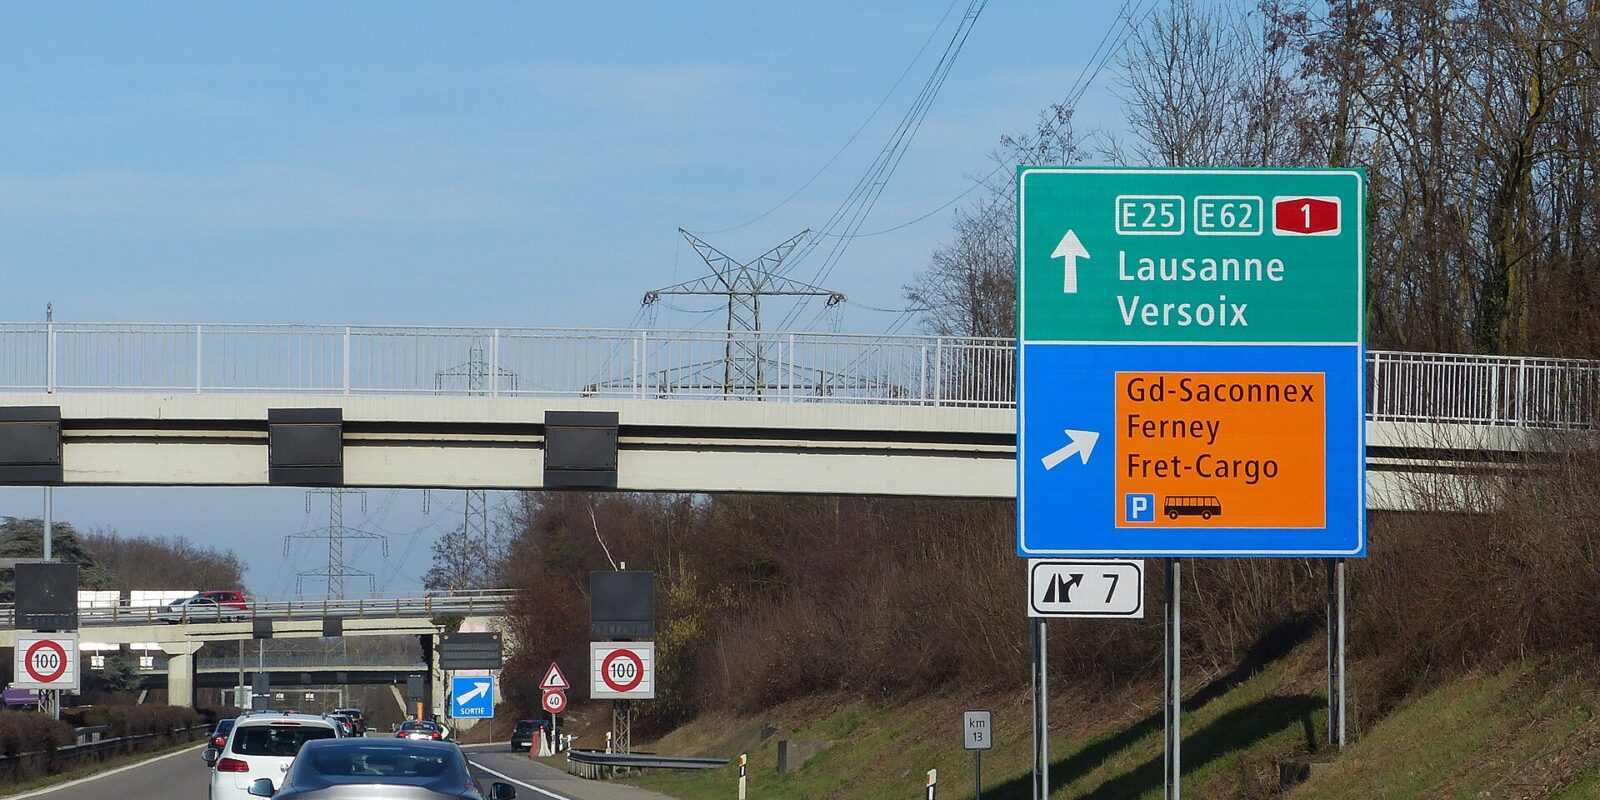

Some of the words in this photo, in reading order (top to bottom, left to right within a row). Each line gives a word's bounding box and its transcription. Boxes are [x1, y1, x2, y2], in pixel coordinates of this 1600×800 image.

[1123, 203, 1175, 228] E25
[1201, 203, 1253, 228] E62
[1300, 204, 1310, 229] 1
[1119, 251, 1285, 281] Lausanne
[1117, 295, 1248, 326] Versoix
[1127, 377, 1314, 402] Gd-Saconnex
[1128, 415, 1220, 445] Ferney
[1128, 454, 1279, 484] Fret-Cargo
[1132, 497, 1147, 518] P
[1102, 574, 1119, 603] 7
[34, 654, 58, 668] 100
[611, 663, 635, 678] 100
[460, 707, 485, 715] SORTIE
[549, 696, 560, 705] 40
[969, 717, 986, 728] km
[973, 732, 983, 742] 13
